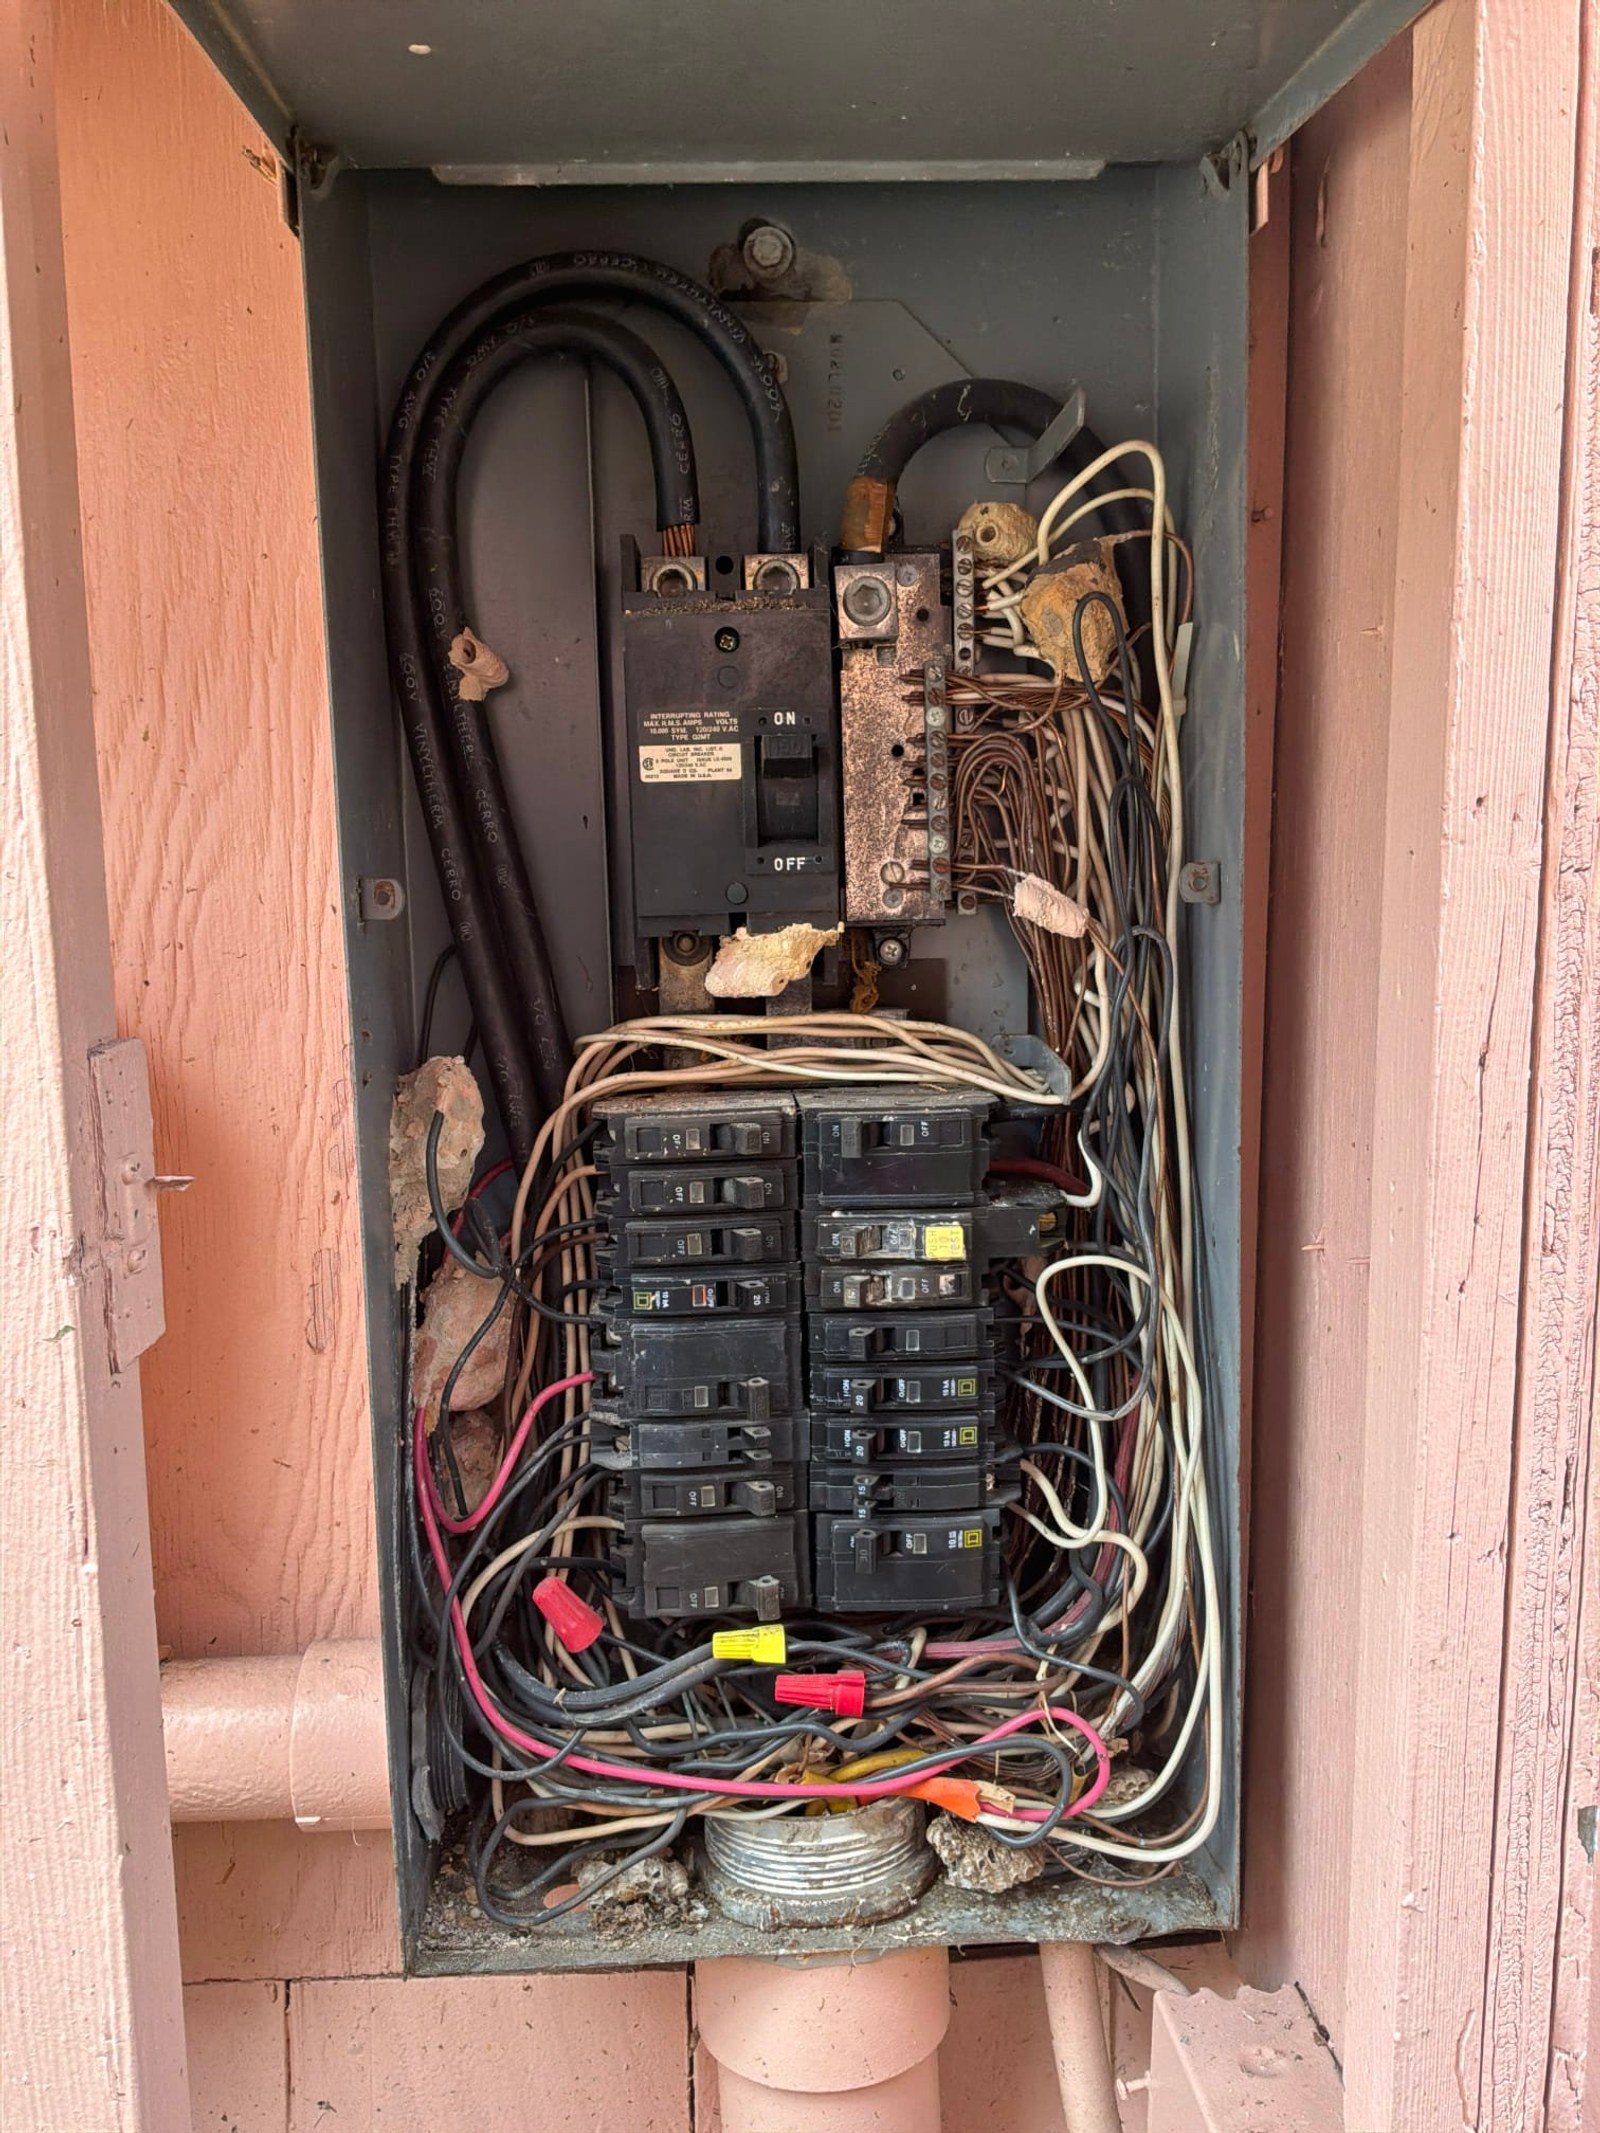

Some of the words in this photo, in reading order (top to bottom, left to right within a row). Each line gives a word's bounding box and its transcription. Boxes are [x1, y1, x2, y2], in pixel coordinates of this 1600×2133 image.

[650, 711, 701, 720] INTERRUPTING
[774, 712, 795, 726] ON
[415, 722, 445, 830] VINYLTHERM
[441, 847, 462, 901] CERRO
[475, 788, 500, 844] CERRO
[774, 857, 806, 871] OFF
[832, 1125, 840, 1137] ON
[921, 1121, 930, 1137] OFF
[762, 1132, 770, 1144] ON
[675, 1186, 684, 1202] OFF
[764, 1182, 772, 1195] ON
[766, 1235, 774, 1247] ON
[832, 1233, 840, 1246] ON
[928, 1230, 937, 1257] PUSH
[939, 1236, 949, 1251] TO
[951, 1230, 961, 1256] TEST
[677, 1239, 685, 1256] OFF
[833, 1281, 841, 1294] ON
[921, 1278, 930, 1294] OFF
[753, 1295, 761, 1306] 20
[856, 1394, 864, 1406] 20
[856, 1445, 864, 1457] 20
[776, 1486, 784, 1498] ON
[858, 1485, 866, 1495] 15
[688, 1491, 697, 1507] OFF
[858, 1508, 866, 1519] 15
[906, 1533, 914, 1549] OFF
[689, 1592, 698, 1608] OFF
